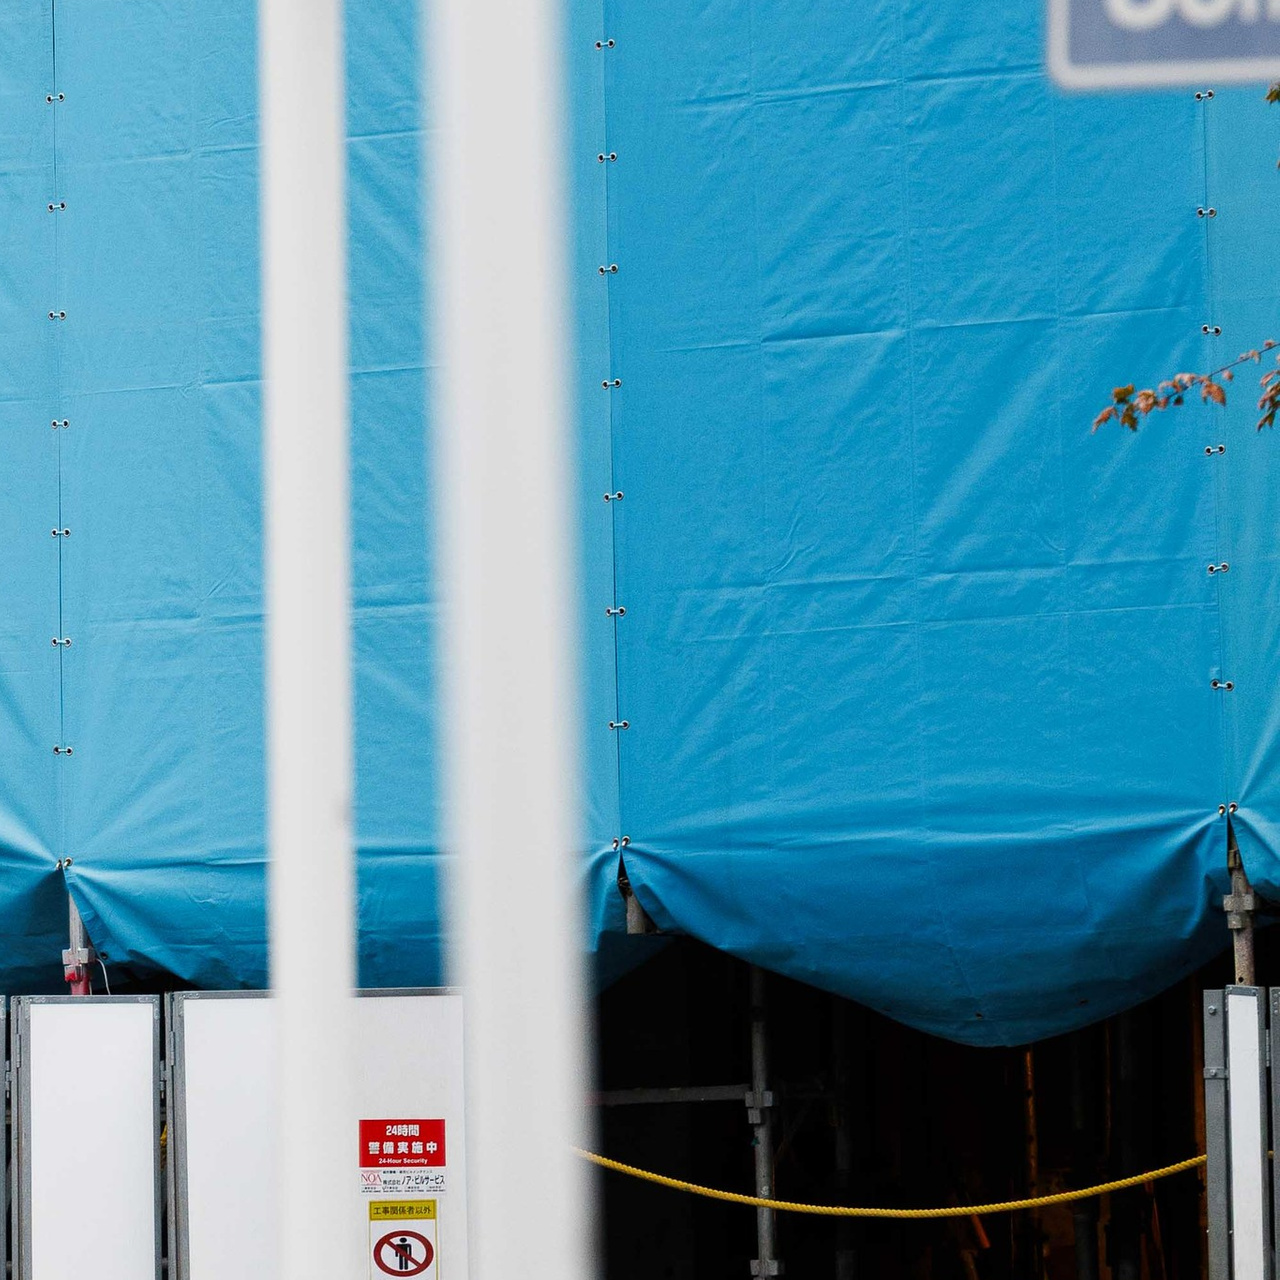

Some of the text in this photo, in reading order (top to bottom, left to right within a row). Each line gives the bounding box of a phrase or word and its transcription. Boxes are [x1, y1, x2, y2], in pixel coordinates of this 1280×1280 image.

[386, 1124, 419, 1136] 24時間
[368, 1141, 437, 1154] 警備実施中
[373, 1205, 431, 1216] 工事関係者以外
